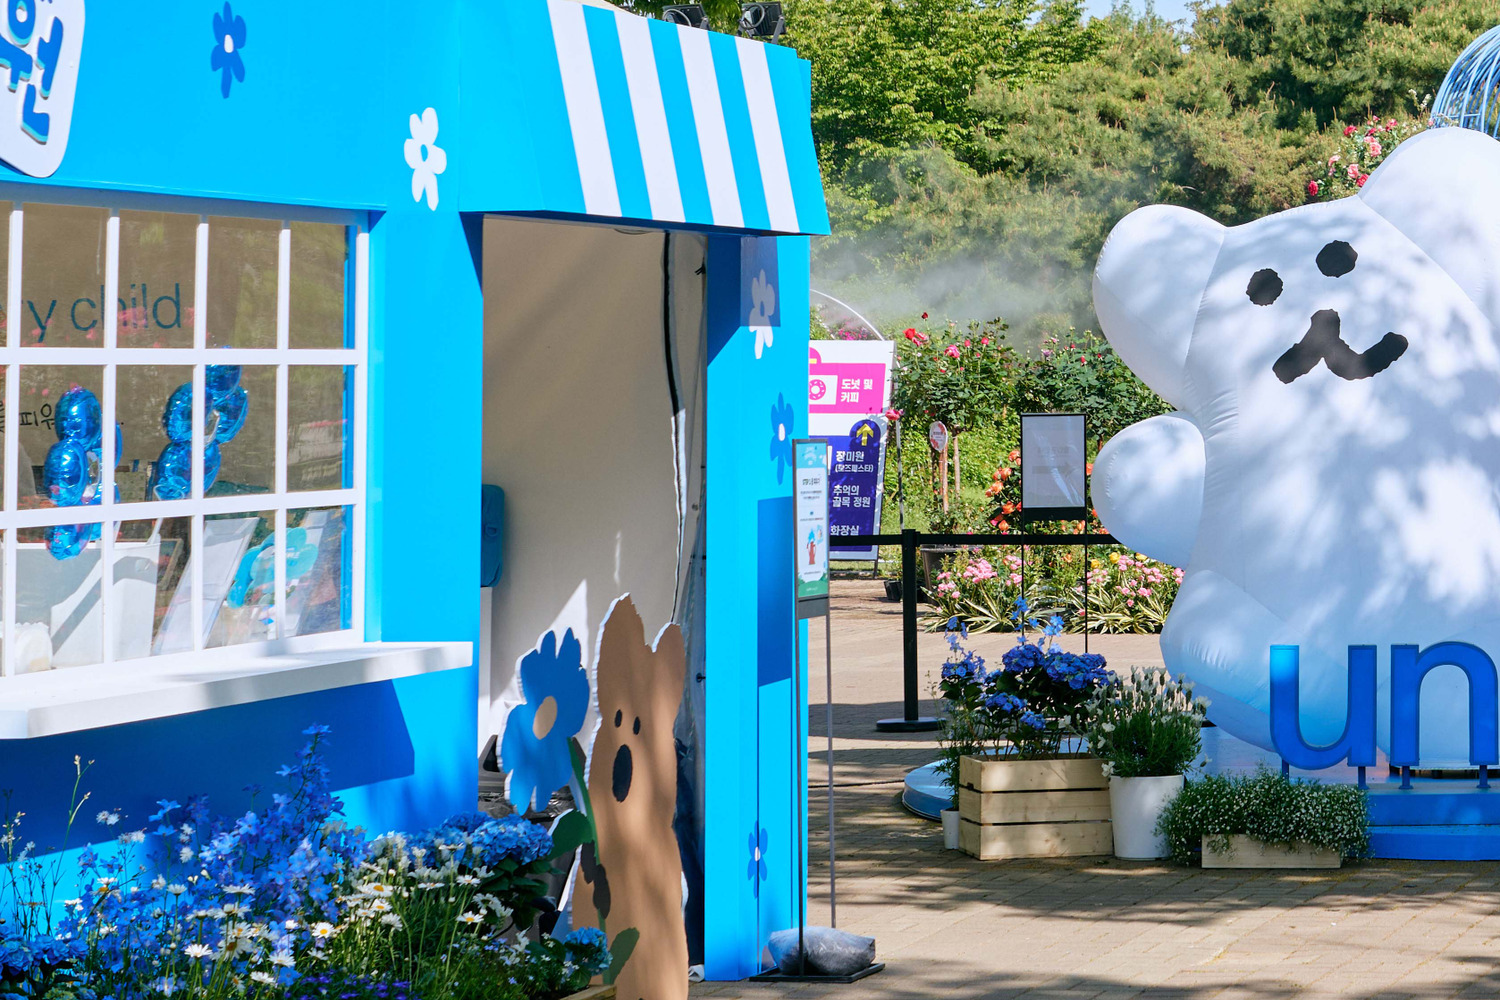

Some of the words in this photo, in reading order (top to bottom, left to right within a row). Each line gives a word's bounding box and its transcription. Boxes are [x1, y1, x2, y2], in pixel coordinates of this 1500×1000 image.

[71, 282, 182, 332] child
[841, 379, 861, 390] 도넛
[863, 379, 873, 390] 및
[841, 391, 859, 403] 커피
[836, 451, 865, 462] 장미원
[833, 485, 860, 496] 추억의
[832, 496, 851, 508] 골목
[853, 496, 871, 508] 정원
[830, 524, 860, 536] 화장실
